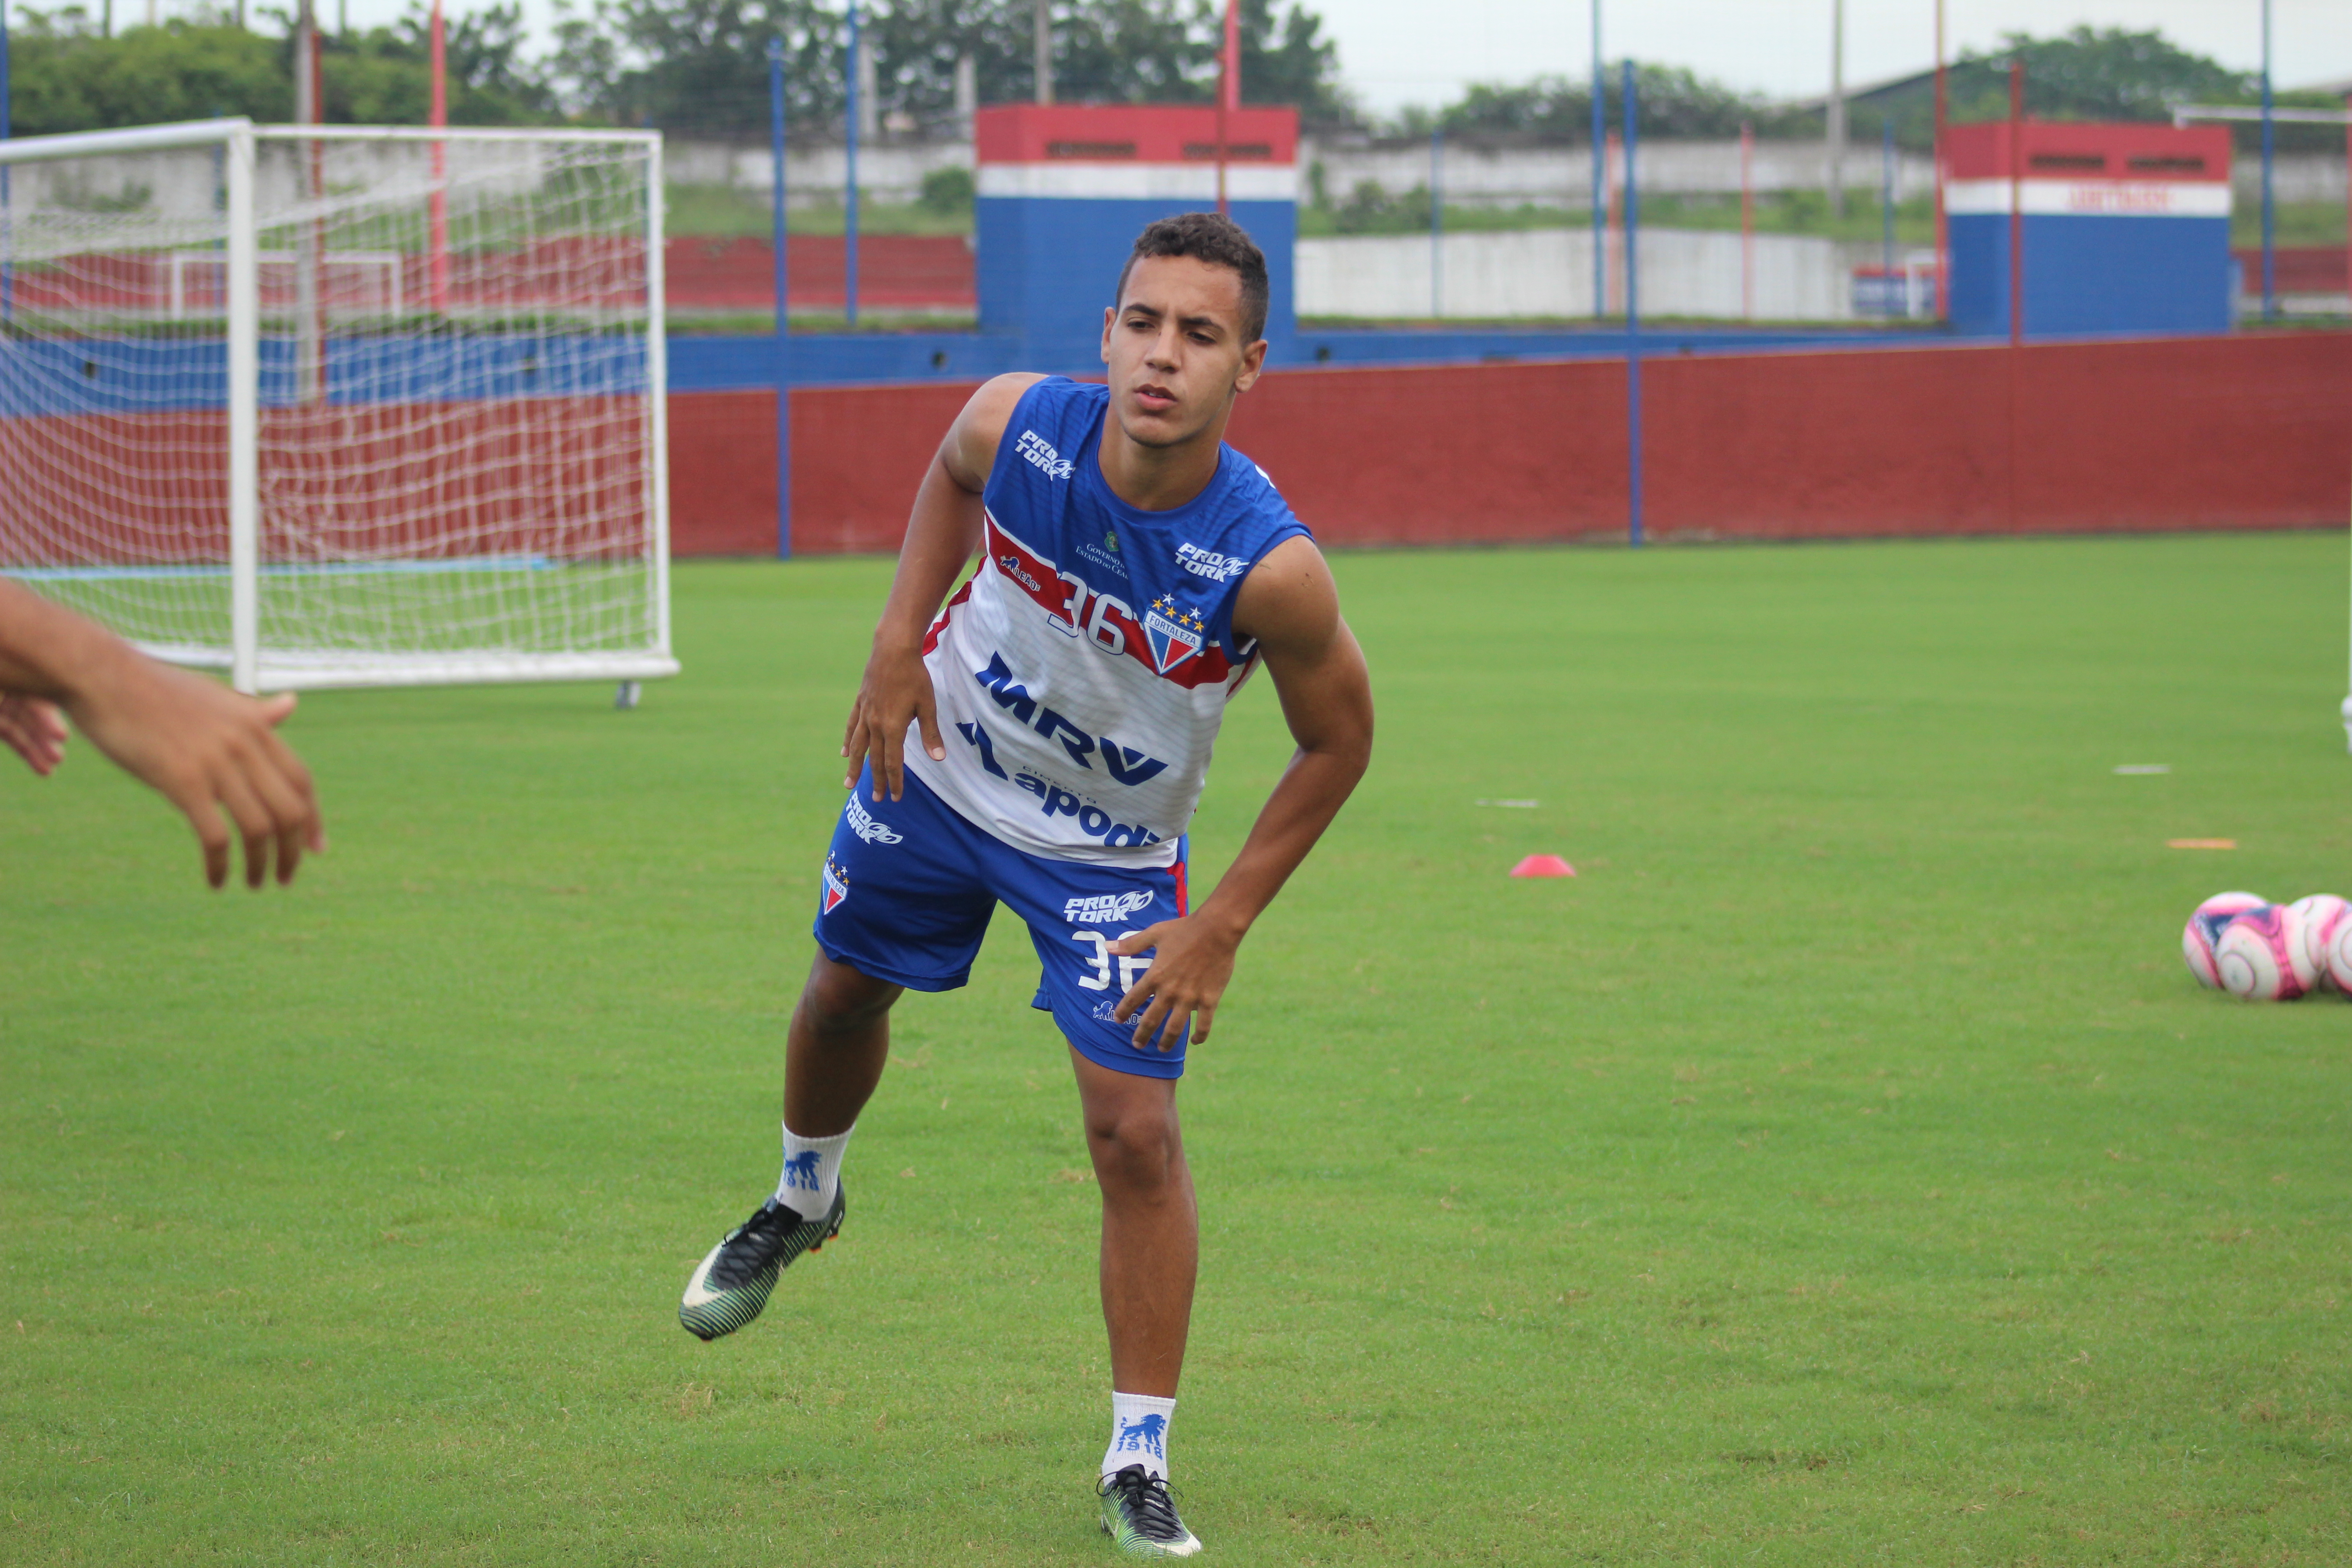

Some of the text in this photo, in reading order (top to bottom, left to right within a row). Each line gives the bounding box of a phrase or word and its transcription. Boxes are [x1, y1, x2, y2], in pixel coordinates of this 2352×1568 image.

[1014, 438, 1060, 482] TORK
[1021, 429, 1058, 462] PRO
[1075, 545, 1102, 564] ESTADO
[1086, 543, 1120, 566] GOVERNO
[1175, 551, 1225, 583] TORK
[1177, 542, 1224, 566] PRO
[1014, 567, 1037, 591] LEÃO
[1047, 571, 1134, 656] 36
[1149, 615, 1196, 645] FORTALEZA
[975, 650, 1169, 786] MRV
[845, 798, 877, 845] TORK
[851, 790, 872, 826] PRO
[1063, 907, 1130, 924] TORK
[1065, 894, 1116, 911] PRO
[1117, 1440, 1164, 1460] 1918
